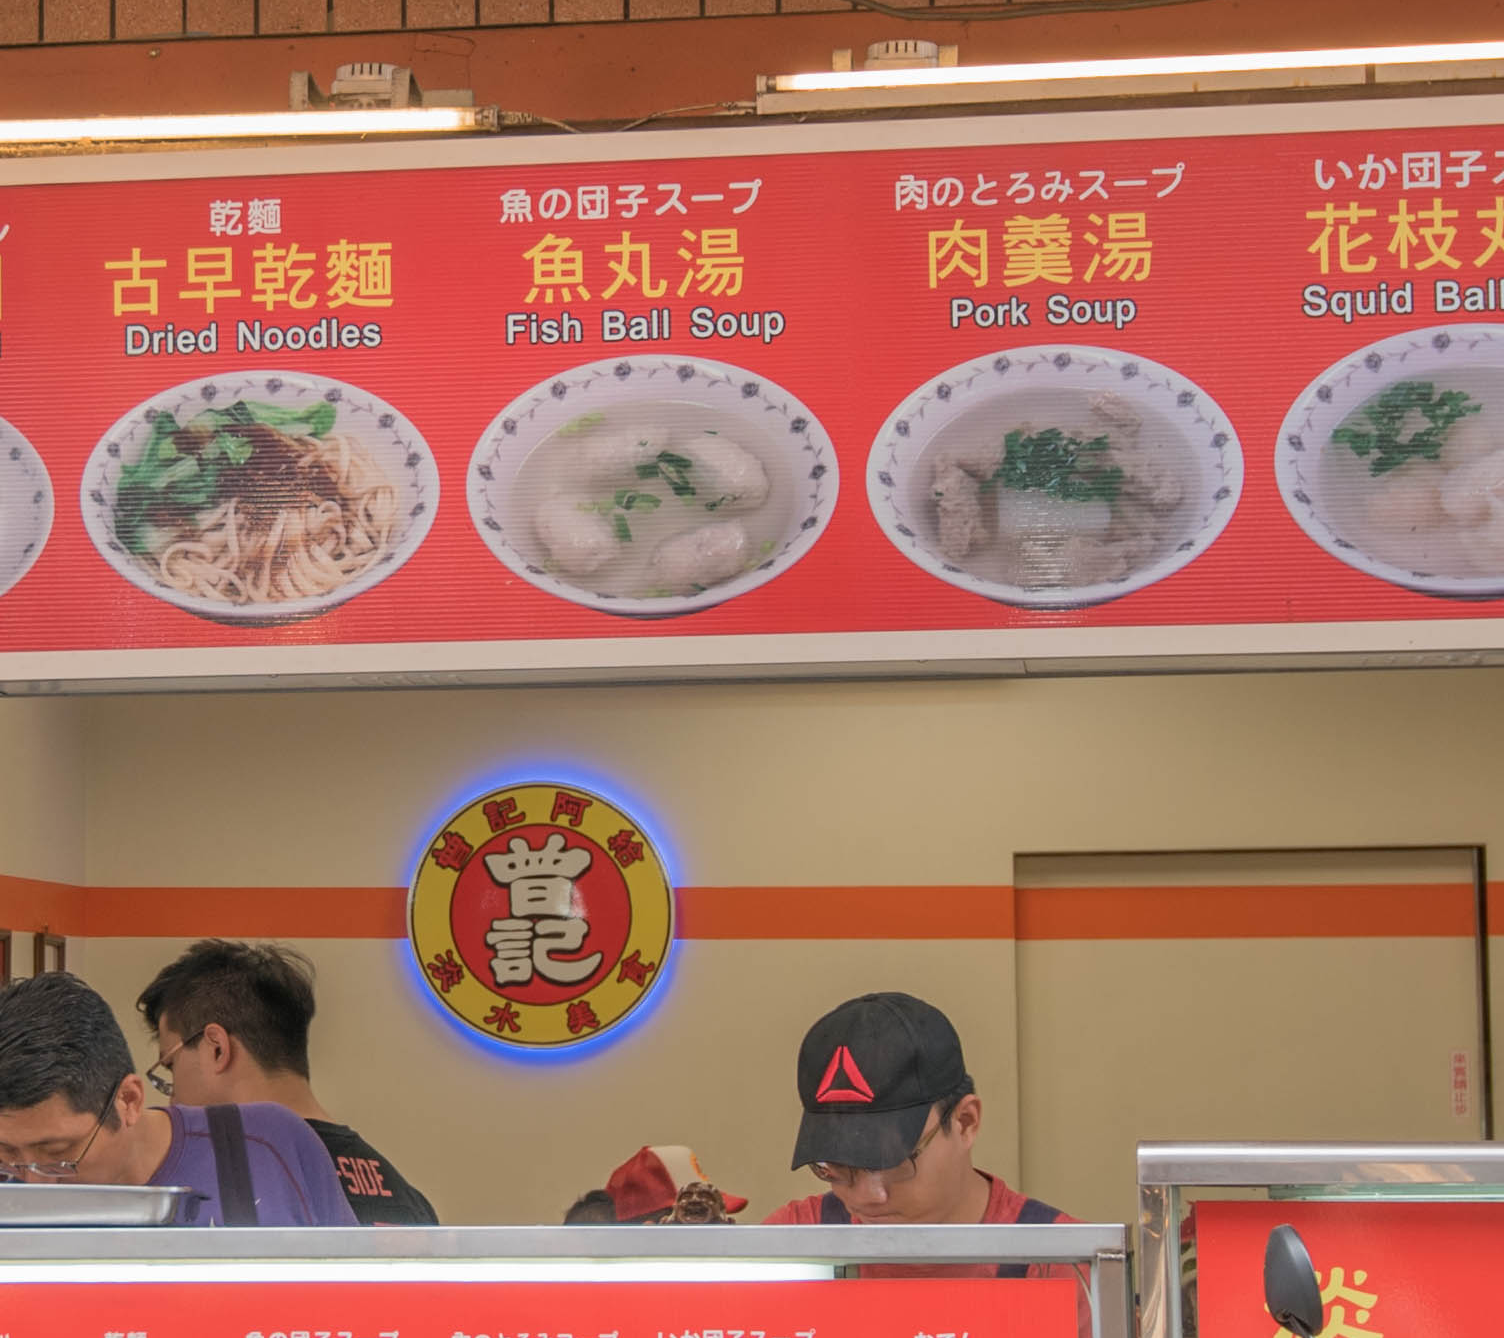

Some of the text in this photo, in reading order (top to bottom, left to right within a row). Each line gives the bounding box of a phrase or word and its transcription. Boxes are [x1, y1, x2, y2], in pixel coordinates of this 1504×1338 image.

[498, 178, 762, 225] 魚の団子スープ
[894, 162, 1186, 212] 肉のとろみスープ
[521, 227, 746, 306] 魚丸湯
[927, 211, 1155, 291] 肉羹湯
[104, 239, 395, 318] 古早乾麵
[1301, 281, 1415, 323] Squid
[505, 306, 786, 346] Fish Ball Soup
[949, 293, 1138, 331] Pork Soup
[124, 318, 383, 357] Dried Noodles
[432, 791, 647, 872] 曾記阿給
[484, 833, 603, 987] 曾記
[336, 1156, 392, 1197] SIDE
